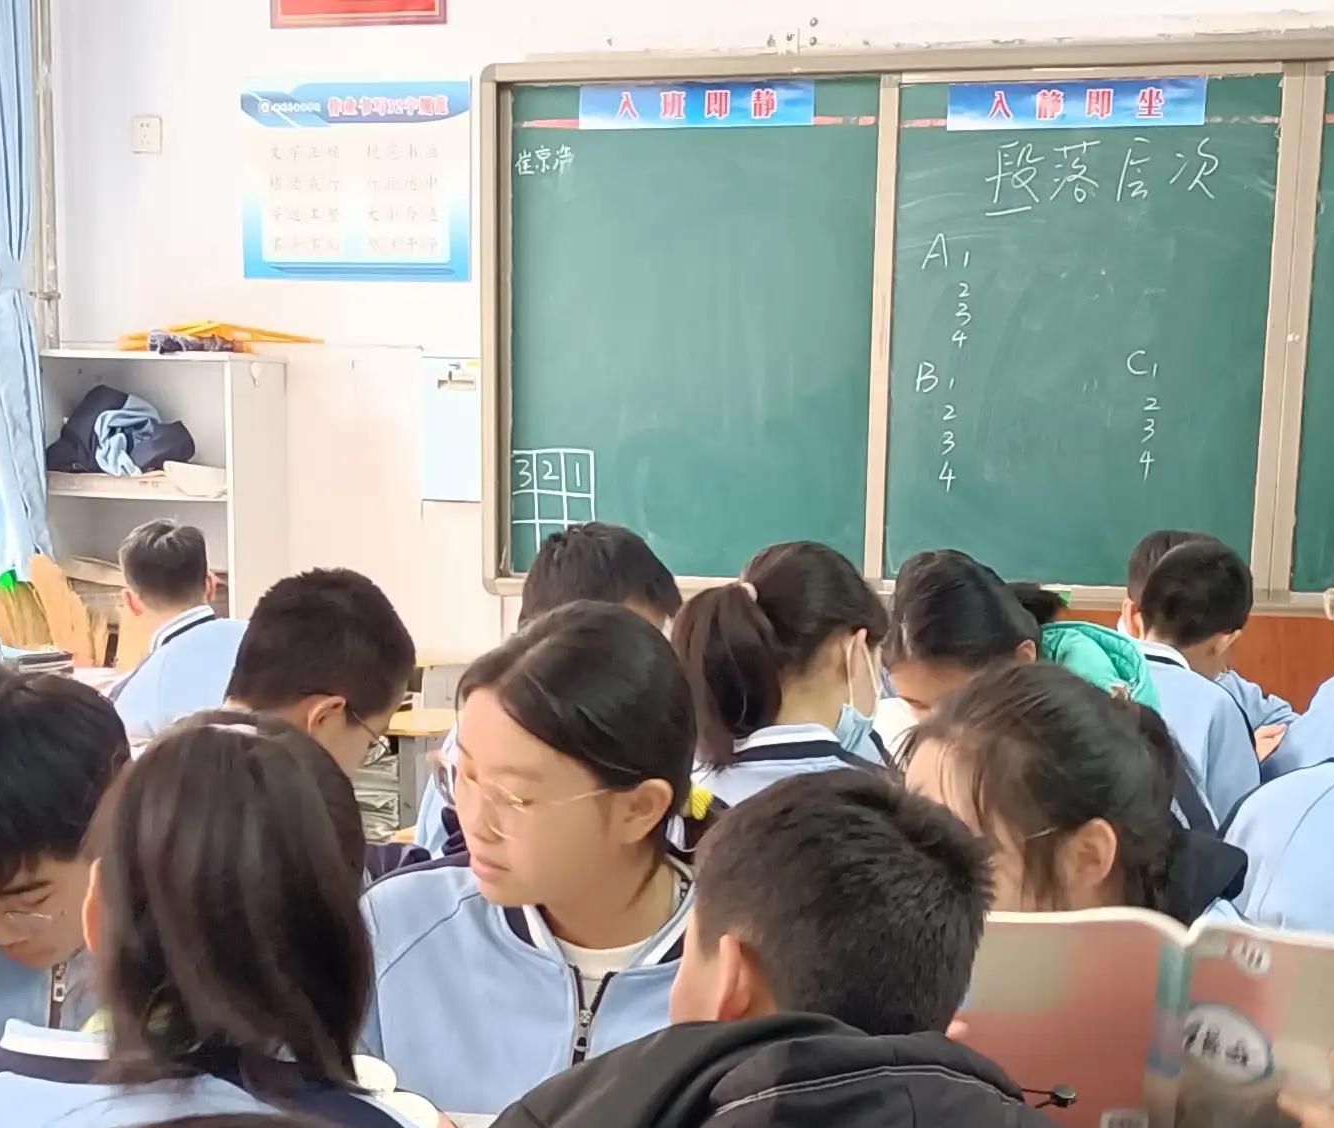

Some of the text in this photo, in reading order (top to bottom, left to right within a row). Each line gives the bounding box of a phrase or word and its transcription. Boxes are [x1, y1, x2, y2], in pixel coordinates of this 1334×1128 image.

[616, 88, 778, 120] 入班即静
[988, 87, 1165, 121] 入静即坐
[984, 136, 1220, 204] 段落层次
[958, 282, 971, 298] 2
[955, 302, 972, 326] 3
[951, 329, 968, 350] 4
[942, 404, 957, 421] 2
[1144, 397, 1161, 411] 2
[1141, 418, 1156, 443] 3
[940, 431, 956, 455] 3
[938, 461, 956, 492] 4
[1138, 450, 1155, 480] 4
